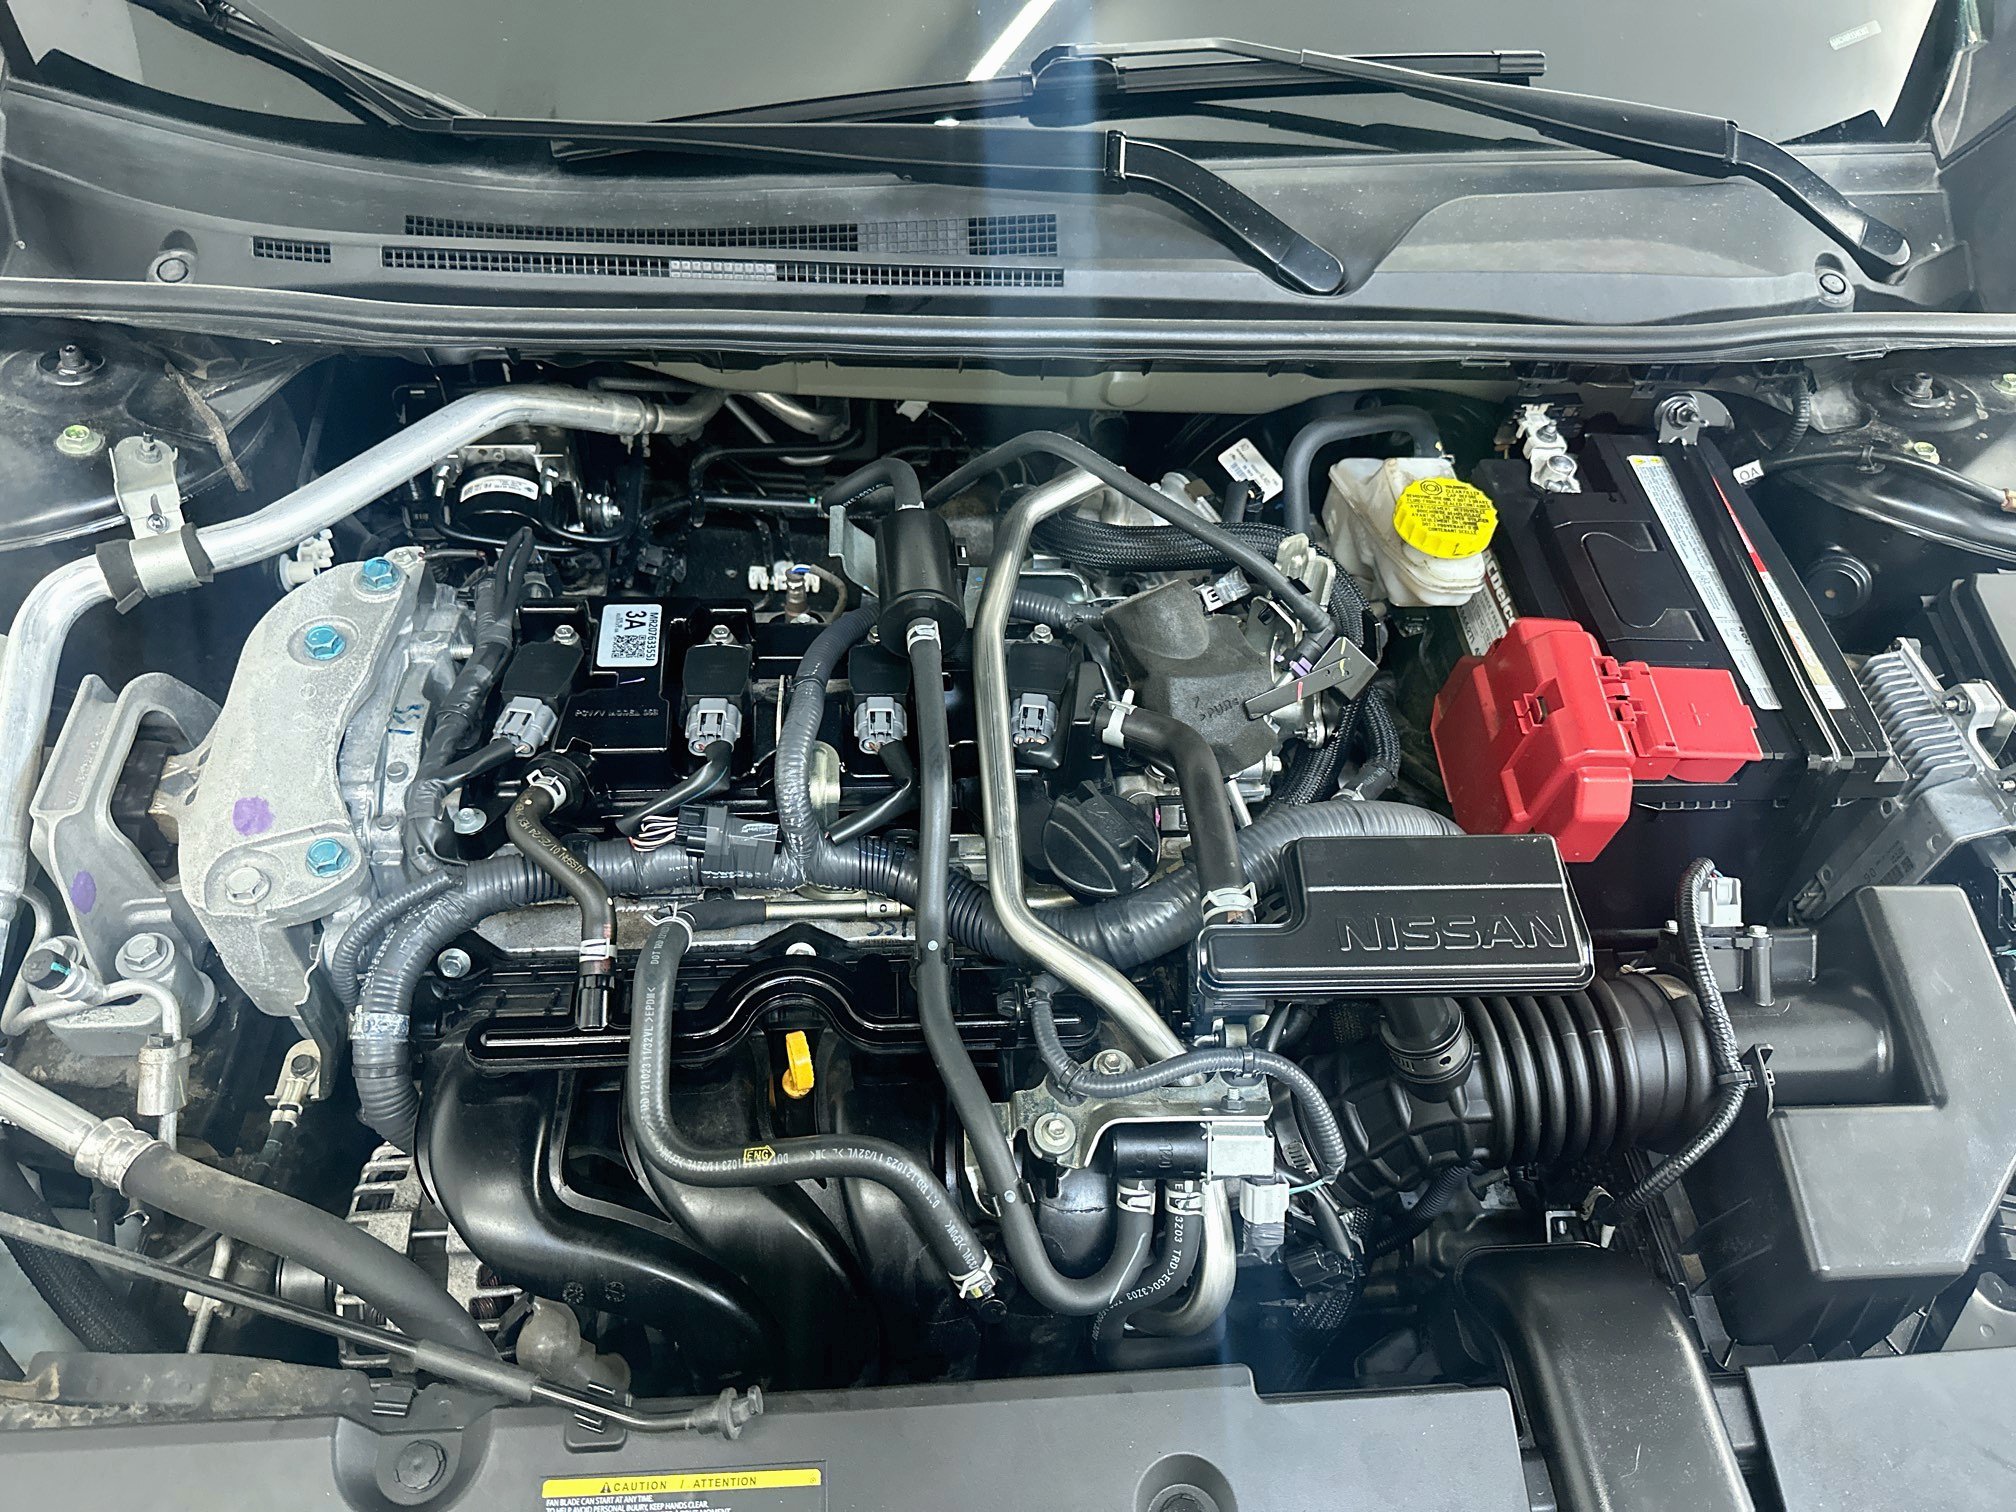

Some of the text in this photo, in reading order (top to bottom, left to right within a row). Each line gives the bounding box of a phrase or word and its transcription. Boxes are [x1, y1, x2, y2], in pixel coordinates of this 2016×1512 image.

[626, 611, 647, 630] 3A
[646, 612, 659, 661] MR20763355J
[1337, 914, 1568, 952] NISSAN
[640, 1064, 652, 1093] 121023
[747, 1150, 769, 1160] ENG
[848, 1148, 884, 1162] 11/32VL
[886, 1156, 918, 1182] 121023
[945, 1220, 966, 1251] >EPDM<
[614, 1481, 666, 1491] CAUTION
[694, 1477, 756, 1488] ATTENTION
[649, 1502, 665, 1511] KEEP
[665, 1501, 687, 1510] HANDS
